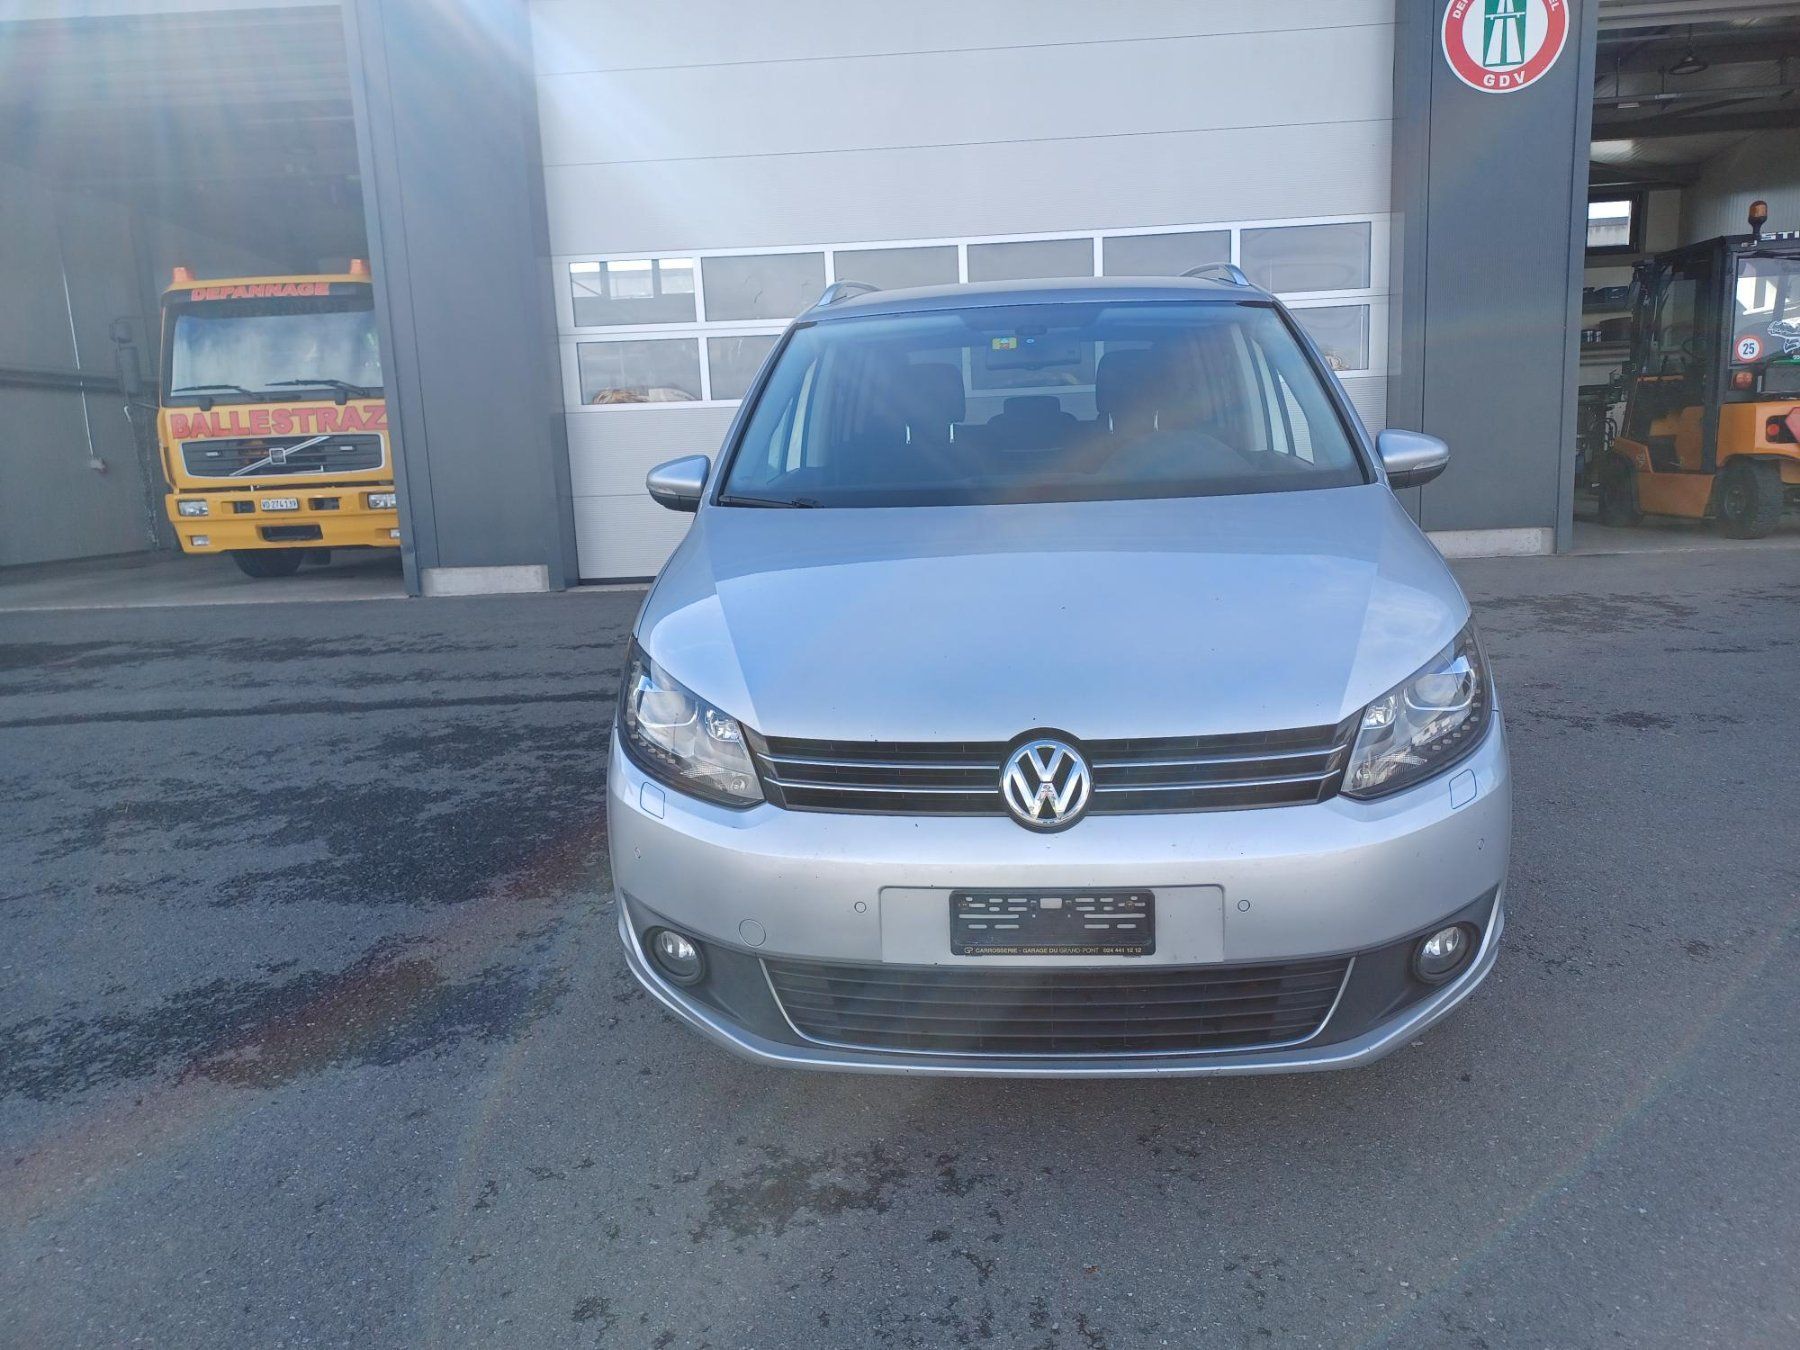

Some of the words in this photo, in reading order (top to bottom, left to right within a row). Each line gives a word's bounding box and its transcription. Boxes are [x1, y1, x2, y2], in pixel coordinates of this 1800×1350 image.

[1483, 70, 1526, 87] GDV
[191, 282, 330, 301] DEPANNAGE
[1742, 343, 1755, 355] 25
[170, 404, 389, 439] BALLESTRAZ
